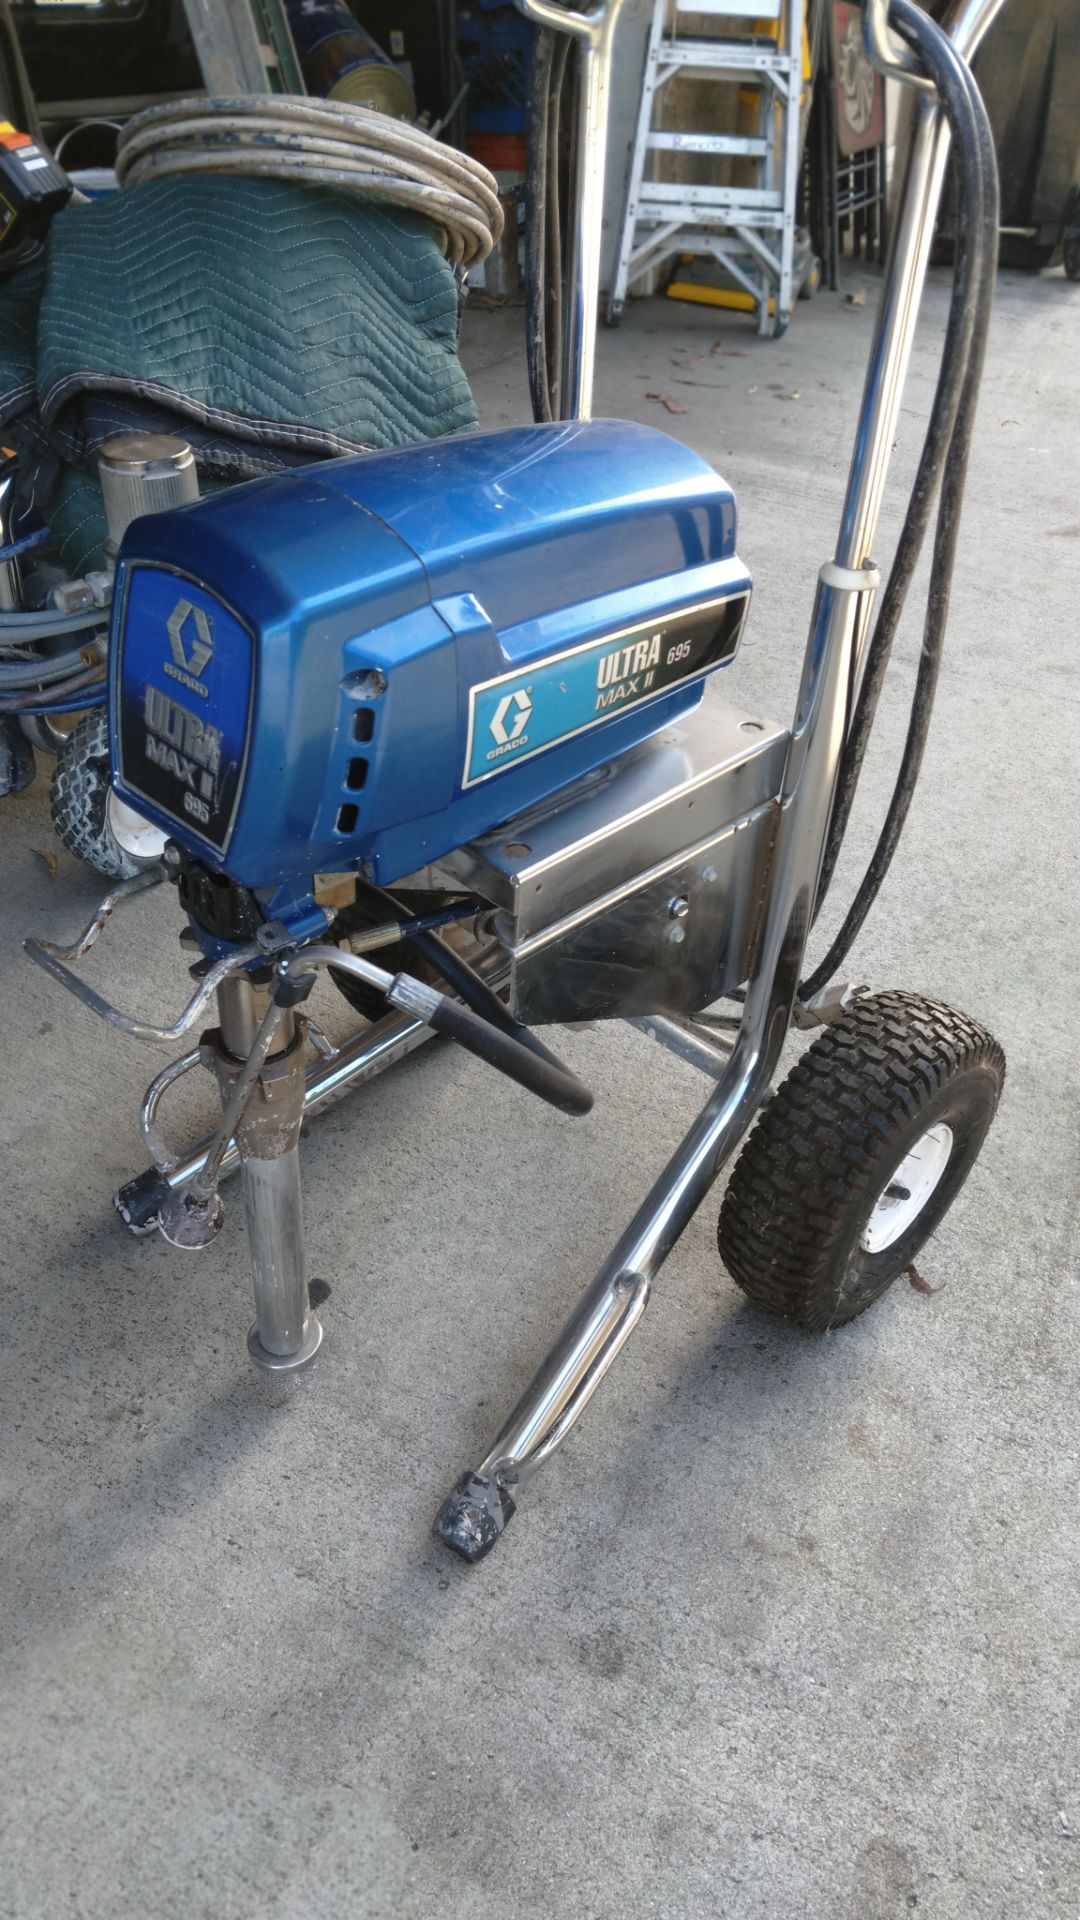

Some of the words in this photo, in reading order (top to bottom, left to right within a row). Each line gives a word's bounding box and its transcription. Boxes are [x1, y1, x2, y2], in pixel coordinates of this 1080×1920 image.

[163, 661, 208, 698] GRACO
[597, 633, 661, 689] ULTRA
[666, 640, 692, 666] 695
[595, 680, 638, 711] MAX
[644, 670, 655, 690] II
[145, 686, 222, 772] ULTRA
[486, 735, 529, 761] GRACO
[145, 733, 197, 790] MAX
[183, 791, 210, 825] 695
